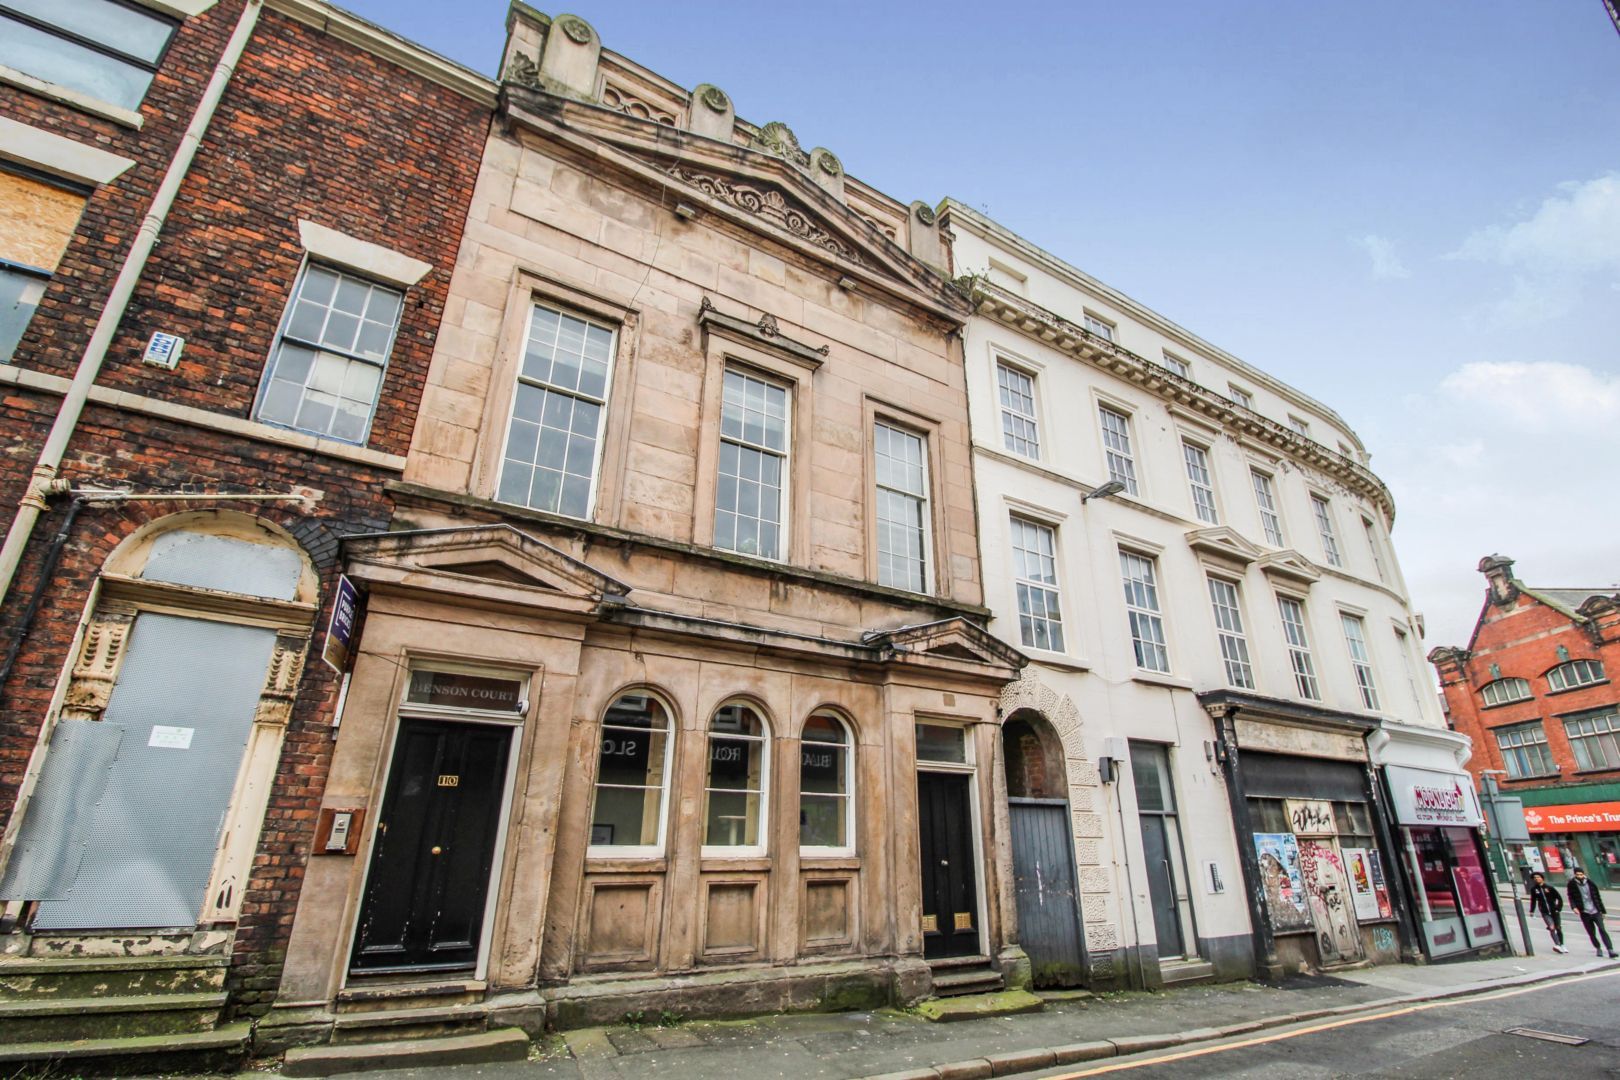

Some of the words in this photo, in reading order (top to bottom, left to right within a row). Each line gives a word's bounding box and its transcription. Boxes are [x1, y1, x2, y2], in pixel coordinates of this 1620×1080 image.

[471, 688, 515, 701] COURT
[1548, 815, 1565, 824] The
[1566, 814, 1602, 823] Prince's
